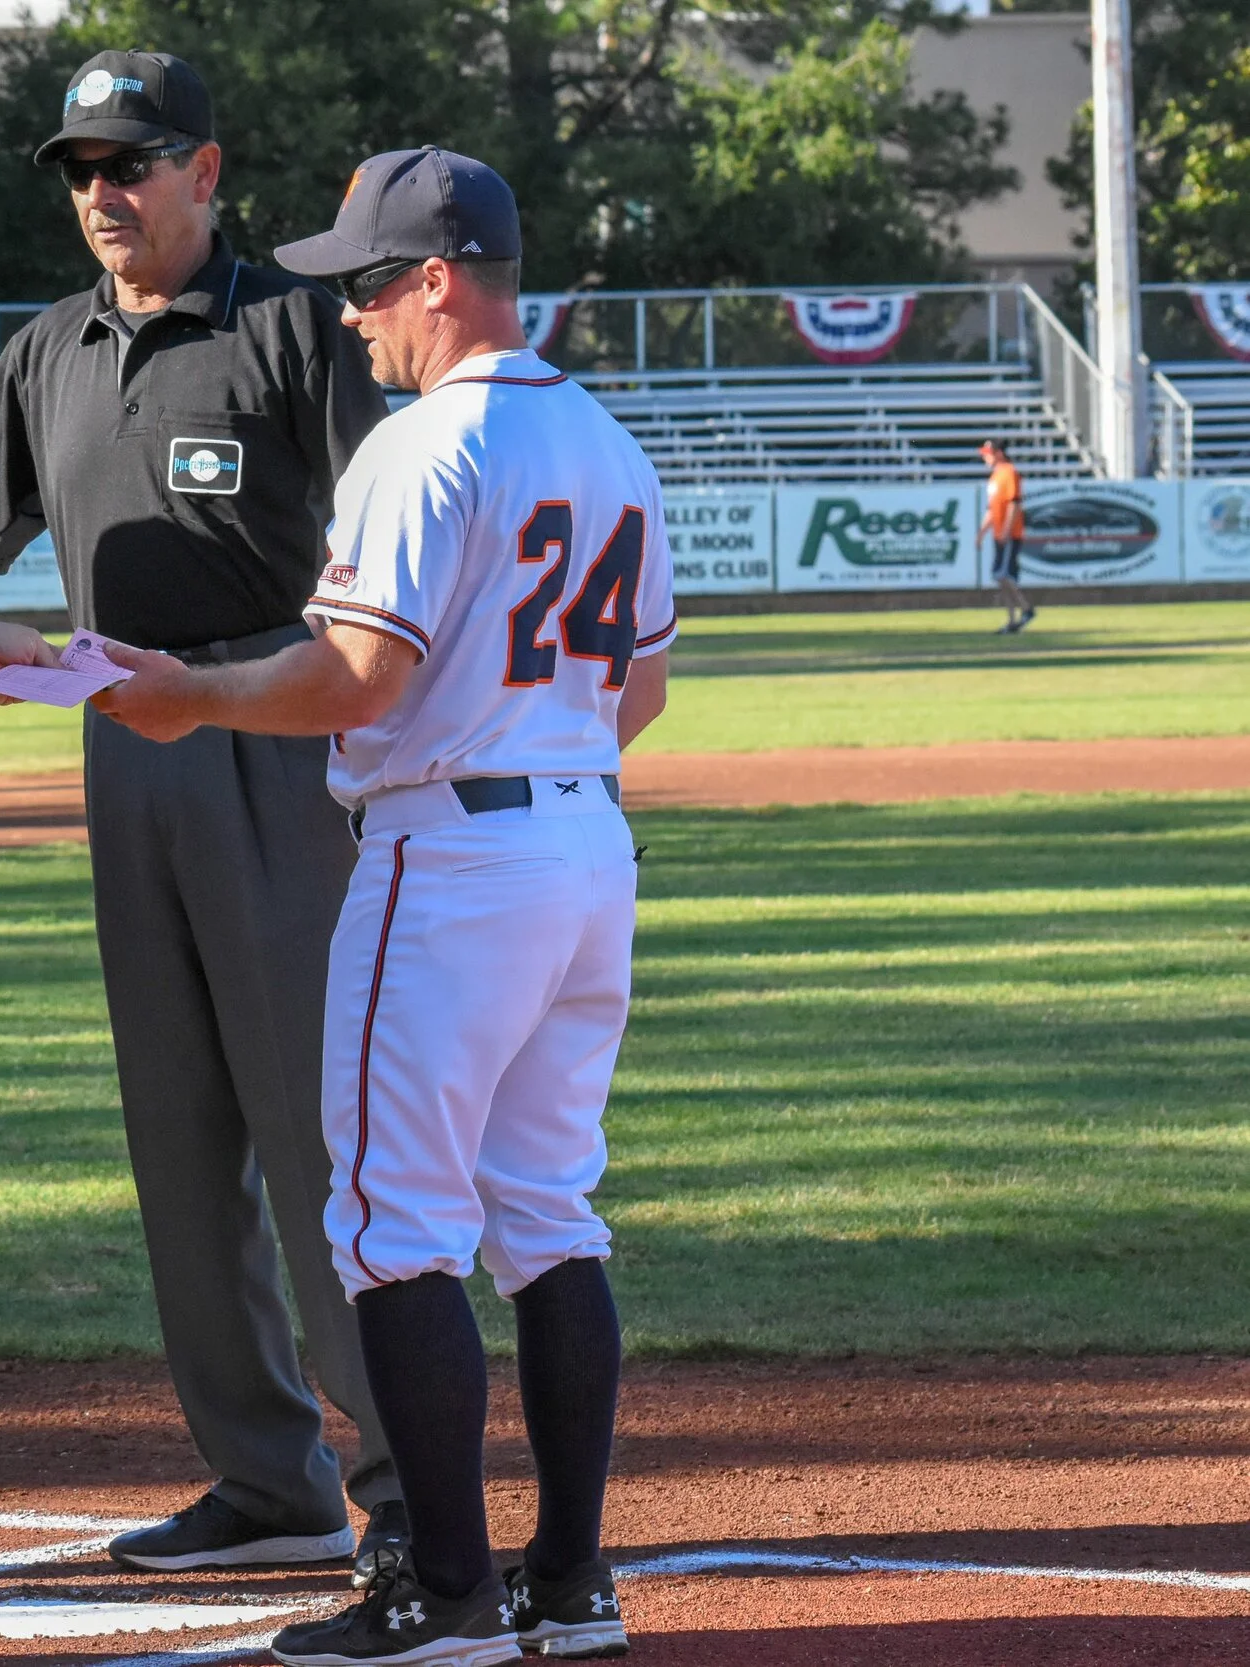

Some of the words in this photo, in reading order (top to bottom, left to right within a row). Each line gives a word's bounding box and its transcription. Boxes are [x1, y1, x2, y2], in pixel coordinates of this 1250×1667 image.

[728, 505, 756, 525] OF
[691, 533, 755, 551] MOON
[798, 497, 959, 567] Reed
[713, 560, 768, 578] CLUB
[502, 500, 646, 692] 24
